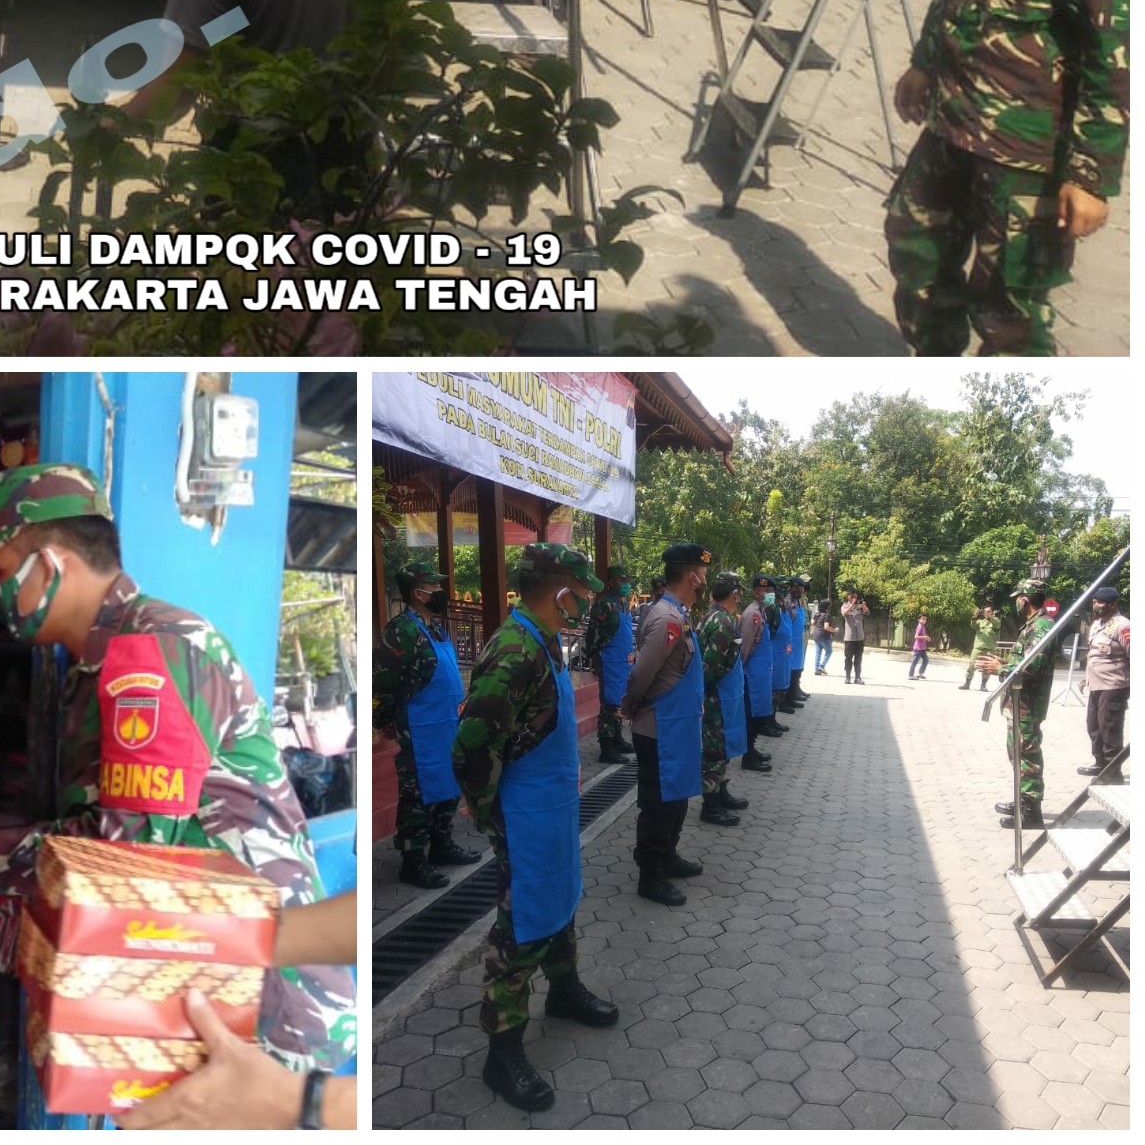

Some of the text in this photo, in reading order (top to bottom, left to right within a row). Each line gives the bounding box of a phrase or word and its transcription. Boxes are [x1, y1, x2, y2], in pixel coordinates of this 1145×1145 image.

[437, 398, 476, 435] PADA
[478, 418, 515, 452] BULAN
[516, 438, 539, 463] SUCI
[467, 383, 537, 439] MASYARAKAT
[550, 382, 575, 434] TNI
[585, 409, 622, 460] POLRI
[500, 455, 526, 480] KOTA
